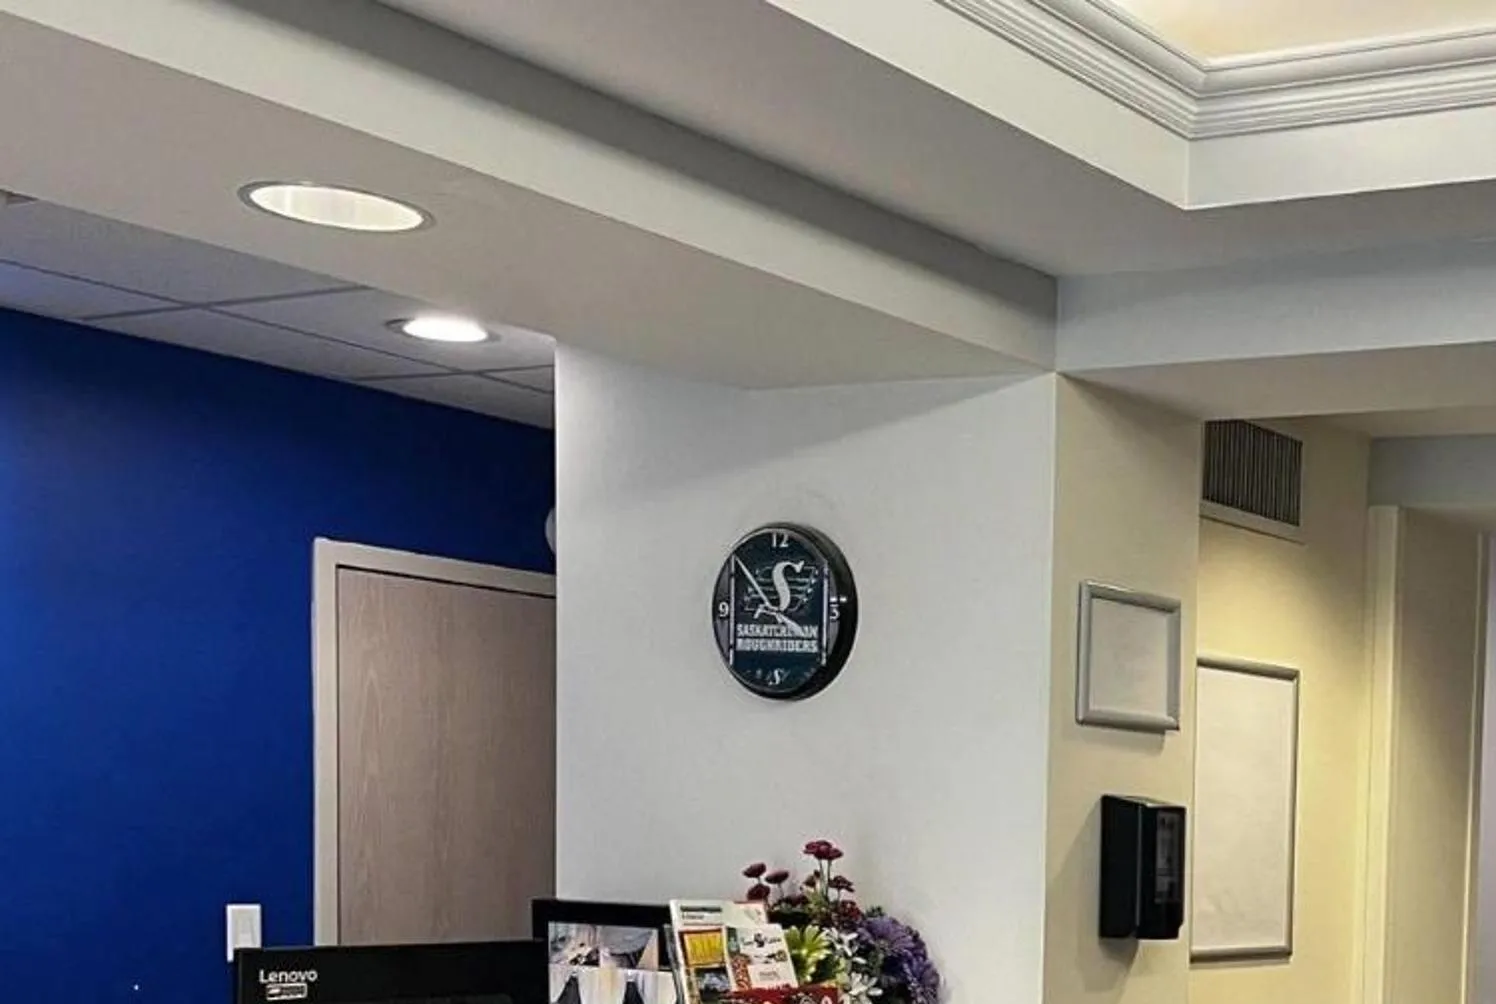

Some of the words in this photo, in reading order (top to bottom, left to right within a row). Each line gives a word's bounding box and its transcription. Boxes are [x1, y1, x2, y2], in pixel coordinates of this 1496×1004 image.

[772, 533, 789, 548] 12
[719, 601, 729, 617] 9
[737, 624, 818, 638] SASKATCHAN
[736, 639, 819, 653] ROUGHRIDERS
[259, 969, 318, 983] Lenovo
